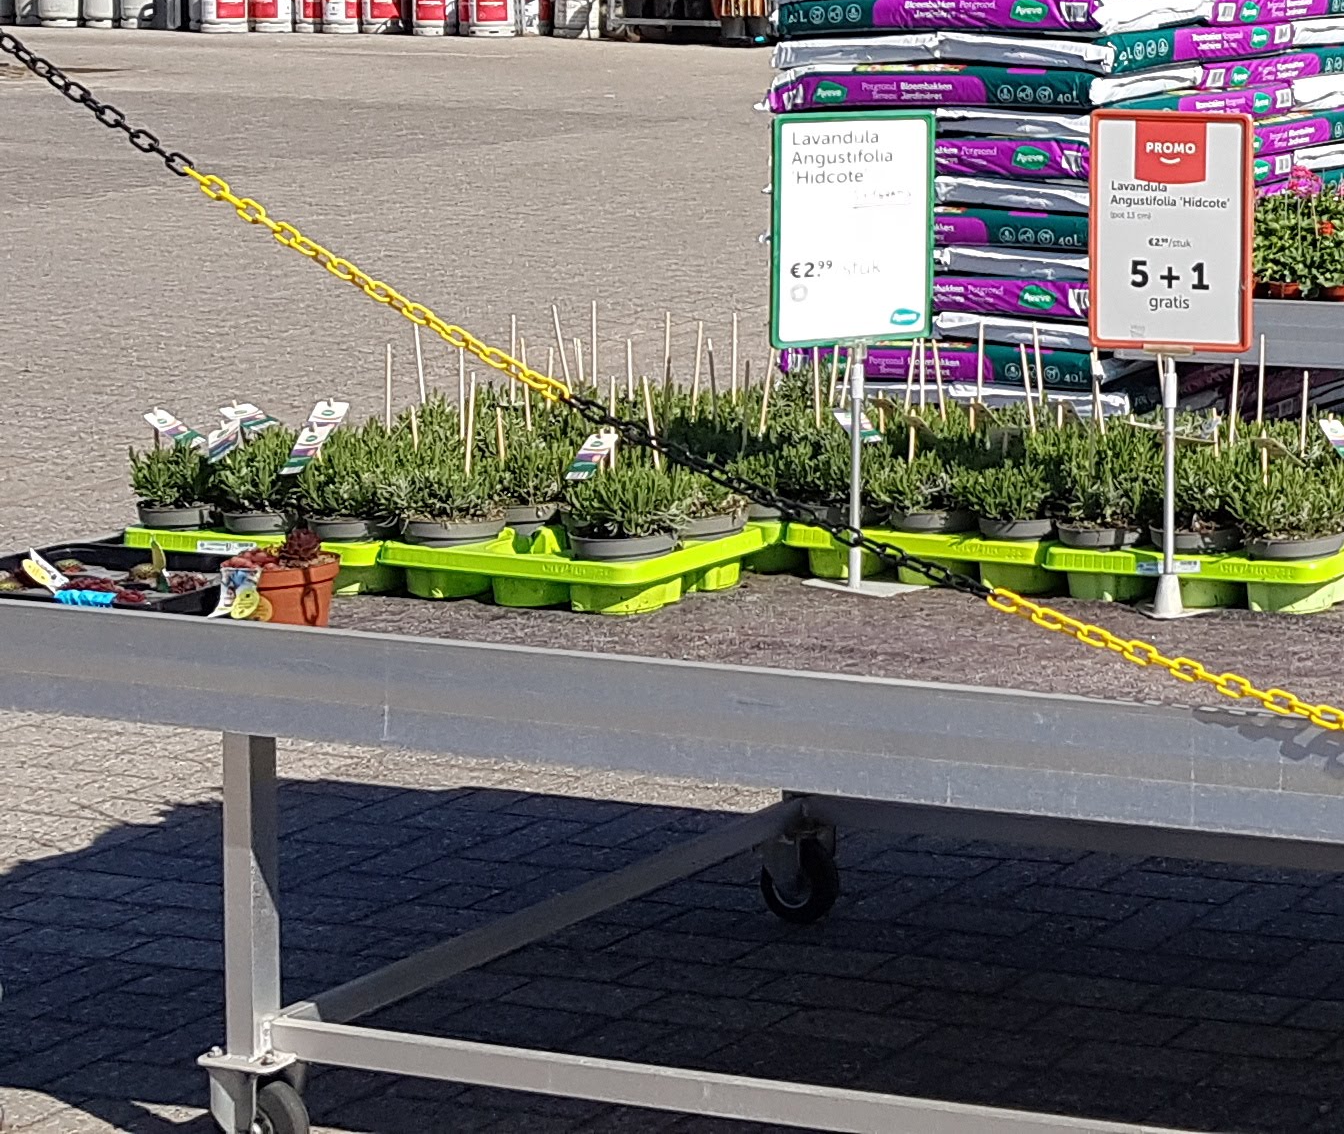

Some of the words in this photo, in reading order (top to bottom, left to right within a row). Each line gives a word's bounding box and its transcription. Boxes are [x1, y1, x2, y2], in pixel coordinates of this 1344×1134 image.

[792, 130, 879, 146] Lavandula
[1145, 141, 1196, 154] PROMO
[791, 149, 894, 169] Angustifolia
[1110, 180, 1168, 193] Lavandula
[1110, 194, 1177, 208] Angustifolia
[1179, 196, 1231, 208] 'Hidcote'
[1130, 259, 1149, 288] 5
[1159, 266, 1180, 289] +
[1191, 262, 1210, 290] 1
[1148, 295, 1190, 312] gratis
